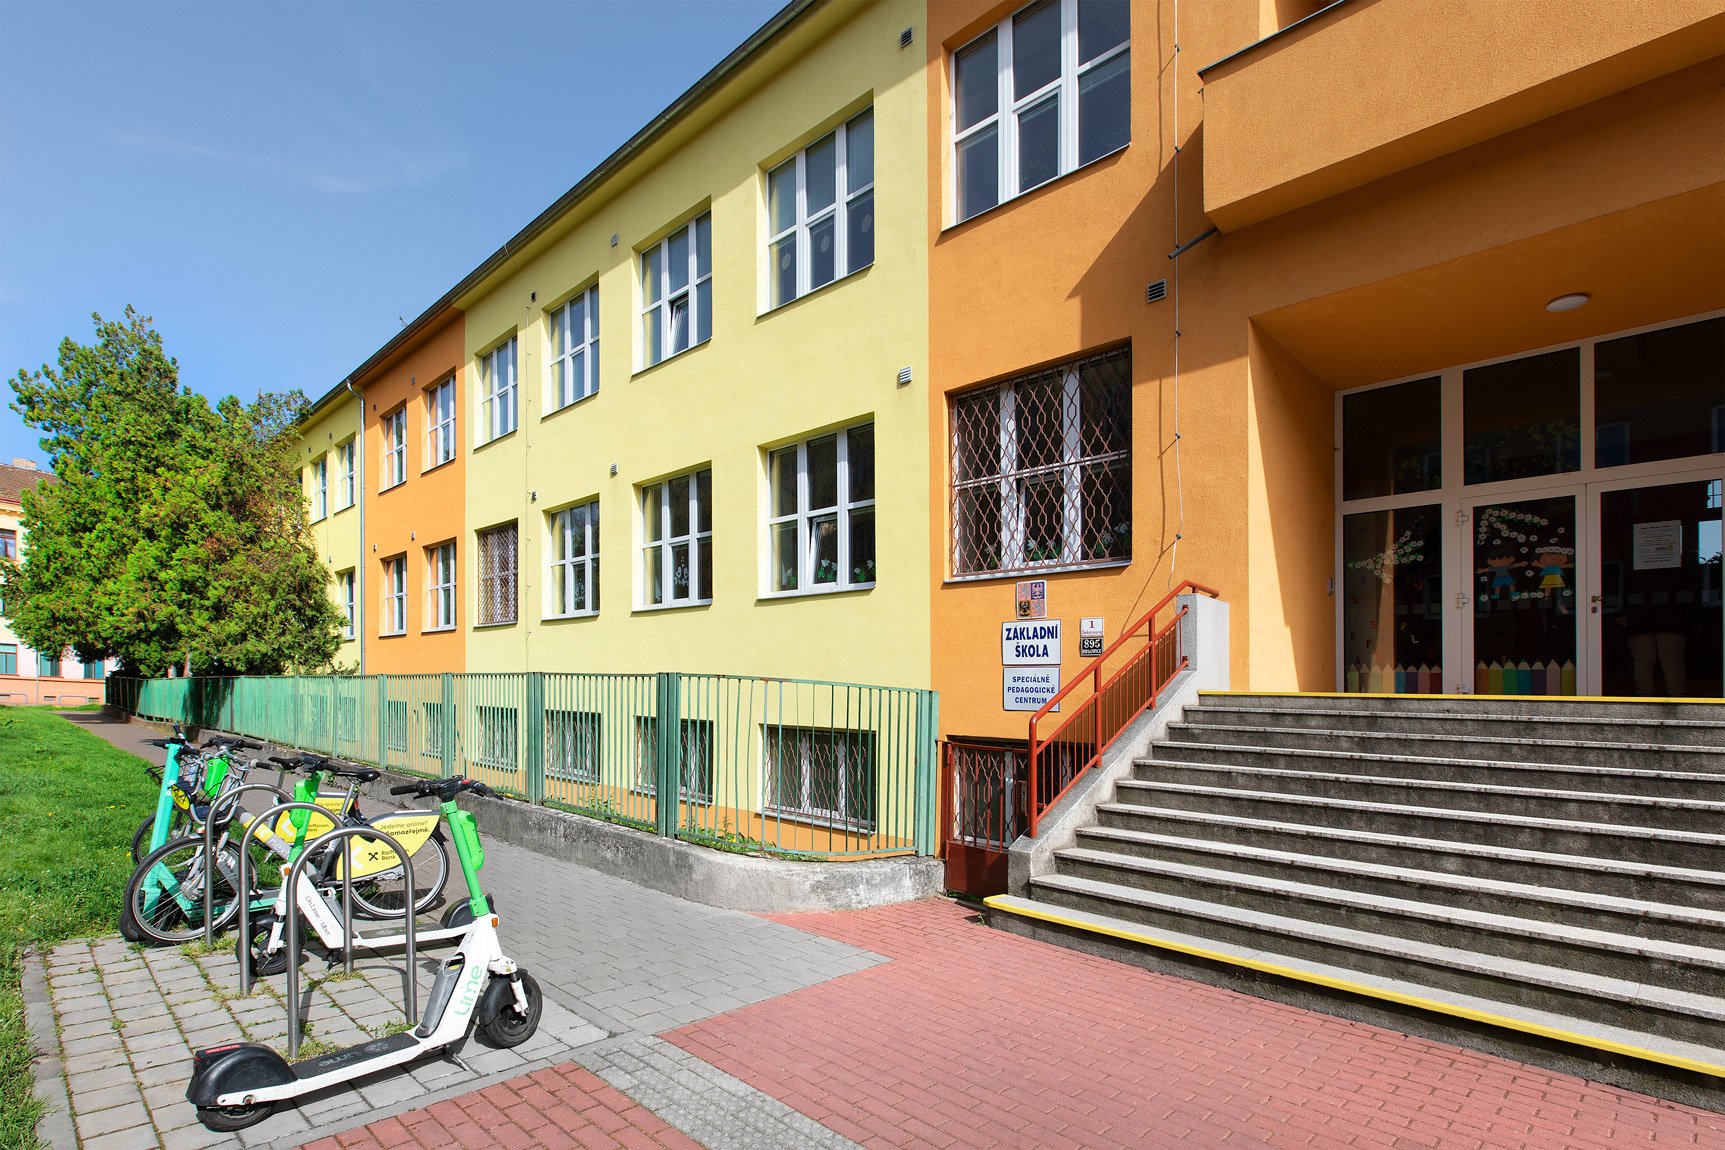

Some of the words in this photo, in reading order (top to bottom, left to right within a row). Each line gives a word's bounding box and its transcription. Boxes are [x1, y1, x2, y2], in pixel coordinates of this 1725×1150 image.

[1088, 620, 1095, 628] 1
[1005, 624, 1059, 641] ZÁKLADNÍ
[1084, 639, 1100, 648] 895
[1015, 642, 1049, 658] ŠKOLA
[1012, 674, 1050, 683] SPECIÁLNĚ
[1007, 684, 1055, 694] PEDAGOGICKÉ
[454, 965, 483, 1016] Lime
